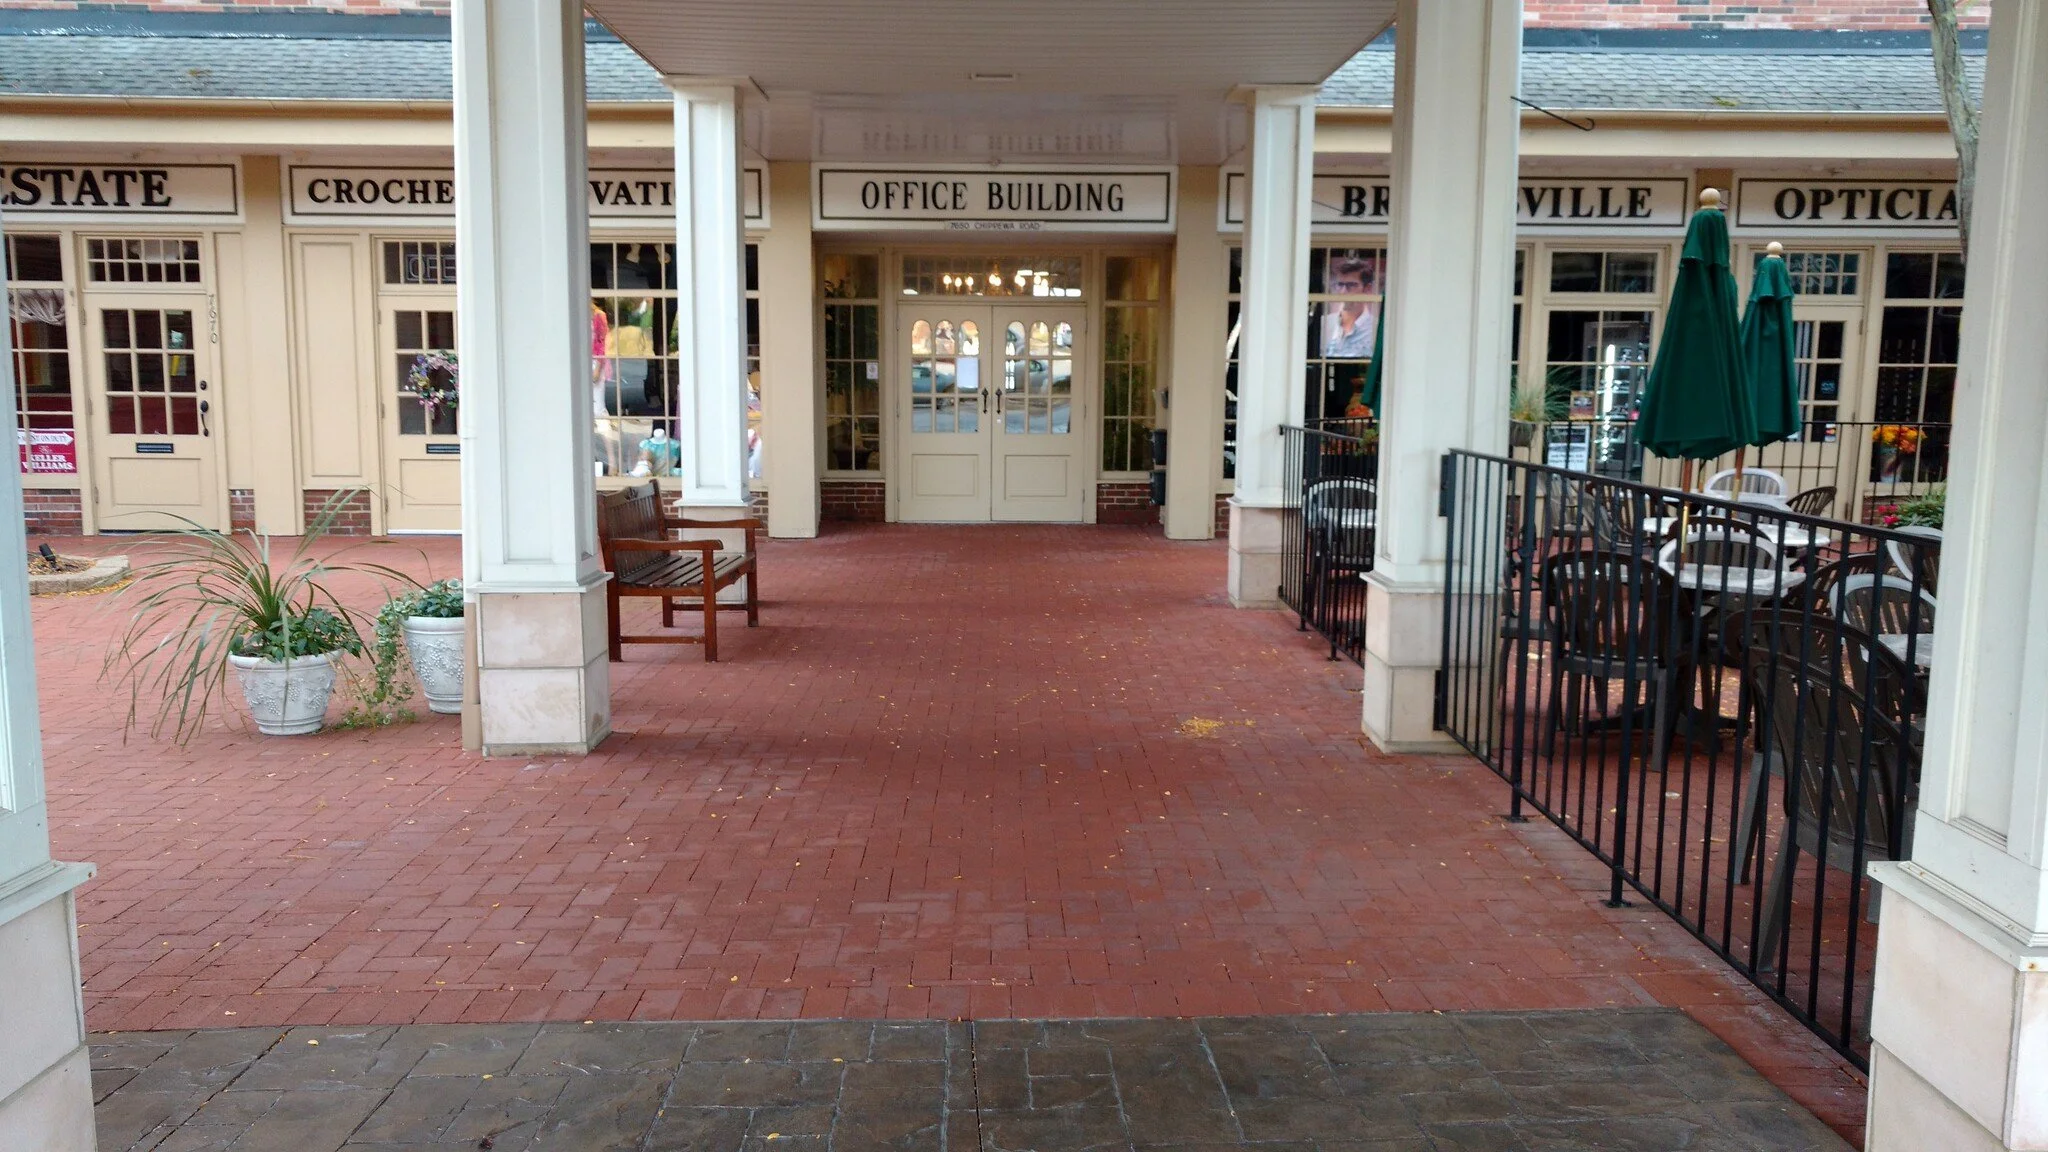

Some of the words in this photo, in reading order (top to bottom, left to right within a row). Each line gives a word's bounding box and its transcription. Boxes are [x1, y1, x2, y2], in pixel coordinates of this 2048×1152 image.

[308, 178, 455, 204] CROCHE
[589, 181, 676, 206] VATI
[861, 181, 968, 210] OFFICE
[987, 182, 1125, 212] BUILDING
[1774, 187, 1958, 220] OPTICIA
